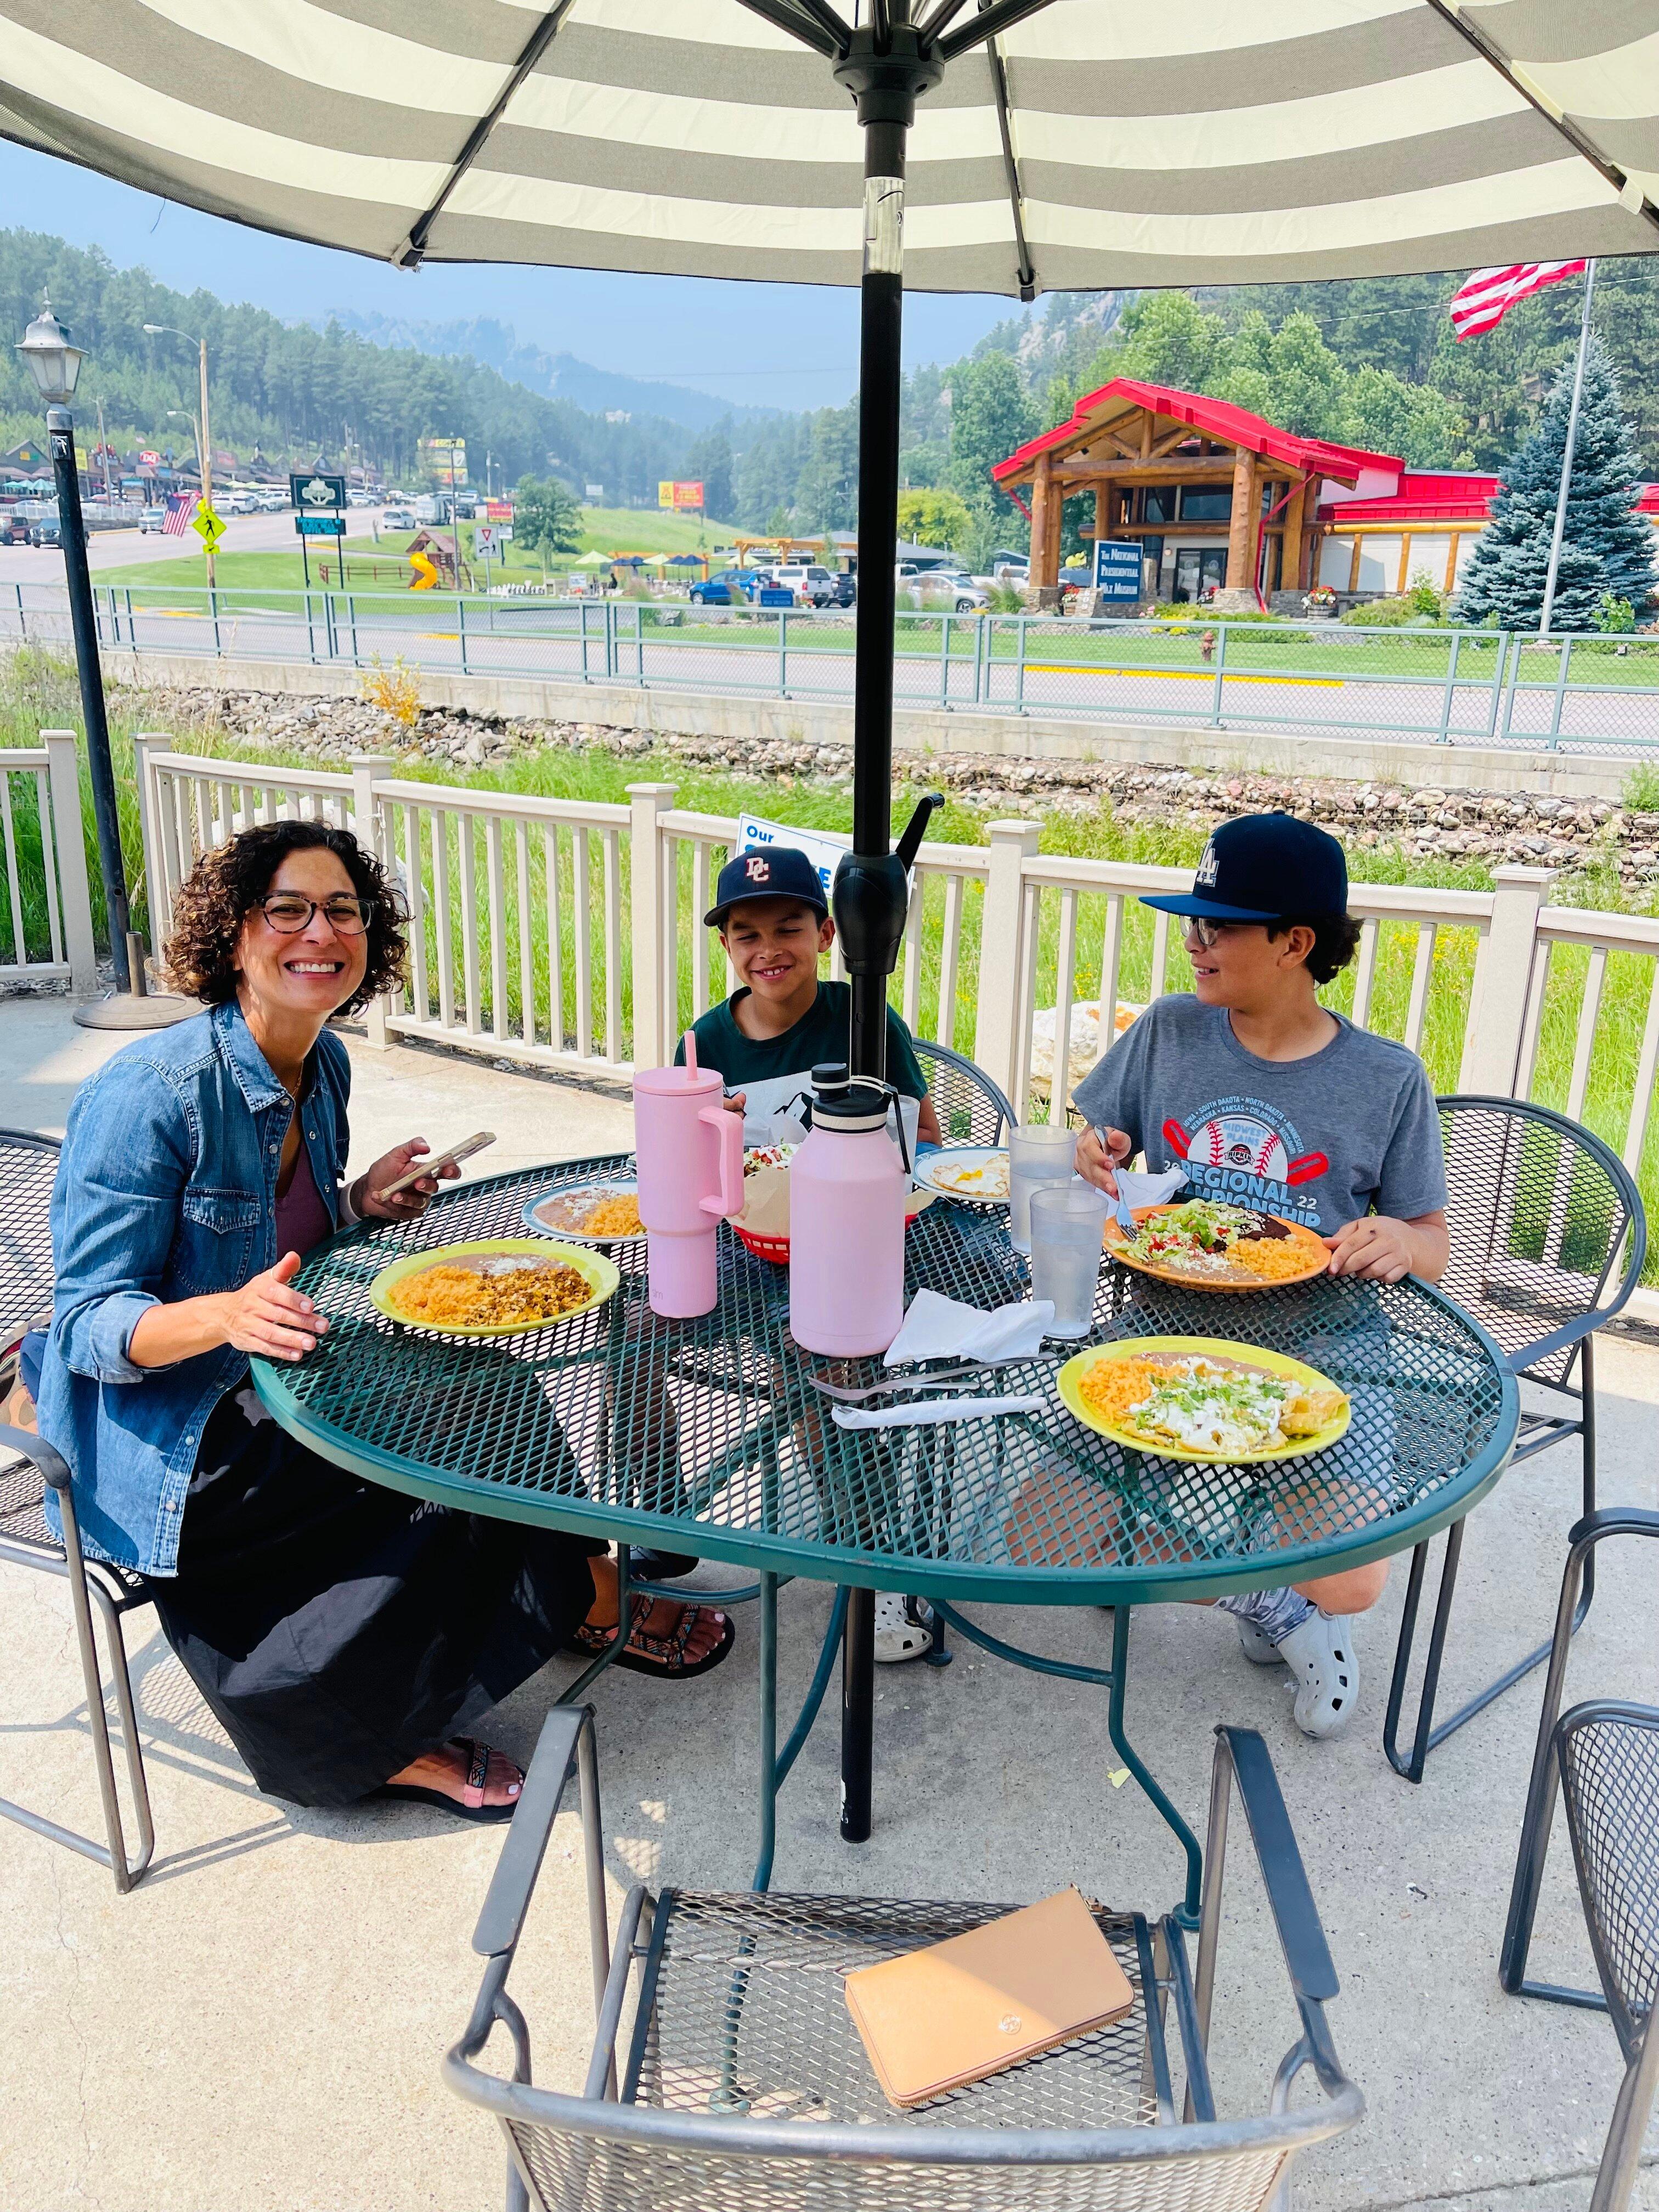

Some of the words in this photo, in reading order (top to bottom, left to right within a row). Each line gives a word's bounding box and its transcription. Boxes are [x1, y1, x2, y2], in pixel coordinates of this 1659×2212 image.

[1111, 549, 1139, 561] NATIONAL
[747, 825, 774, 843] Our
[746, 856, 770, 883] DC
[1183, 1114, 1196, 1127] IOWA
[1199, 1101, 1217, 1113] SOUTH
[1218, 1096, 1240, 1105] DAKOTA
[1245, 1097, 1265, 1107] NORTH
[1264, 1103, 1284, 1120] DAKOTA
[1190, 1110, 1217, 1131] NEBRASKA
[1222, 1105, 1244, 1113] KANSAS
[1250, 1107, 1277, 1126] COLORADO
[1223, 1122, 1266, 1138] MIDWEST
[1227, 1133, 1259, 1147] PLAINS
[1229, 1152, 1251, 1162] RIPKEN
[1181, 1159, 1292, 1205] REGIONAL
[1297, 1195, 1317, 1210] 22
